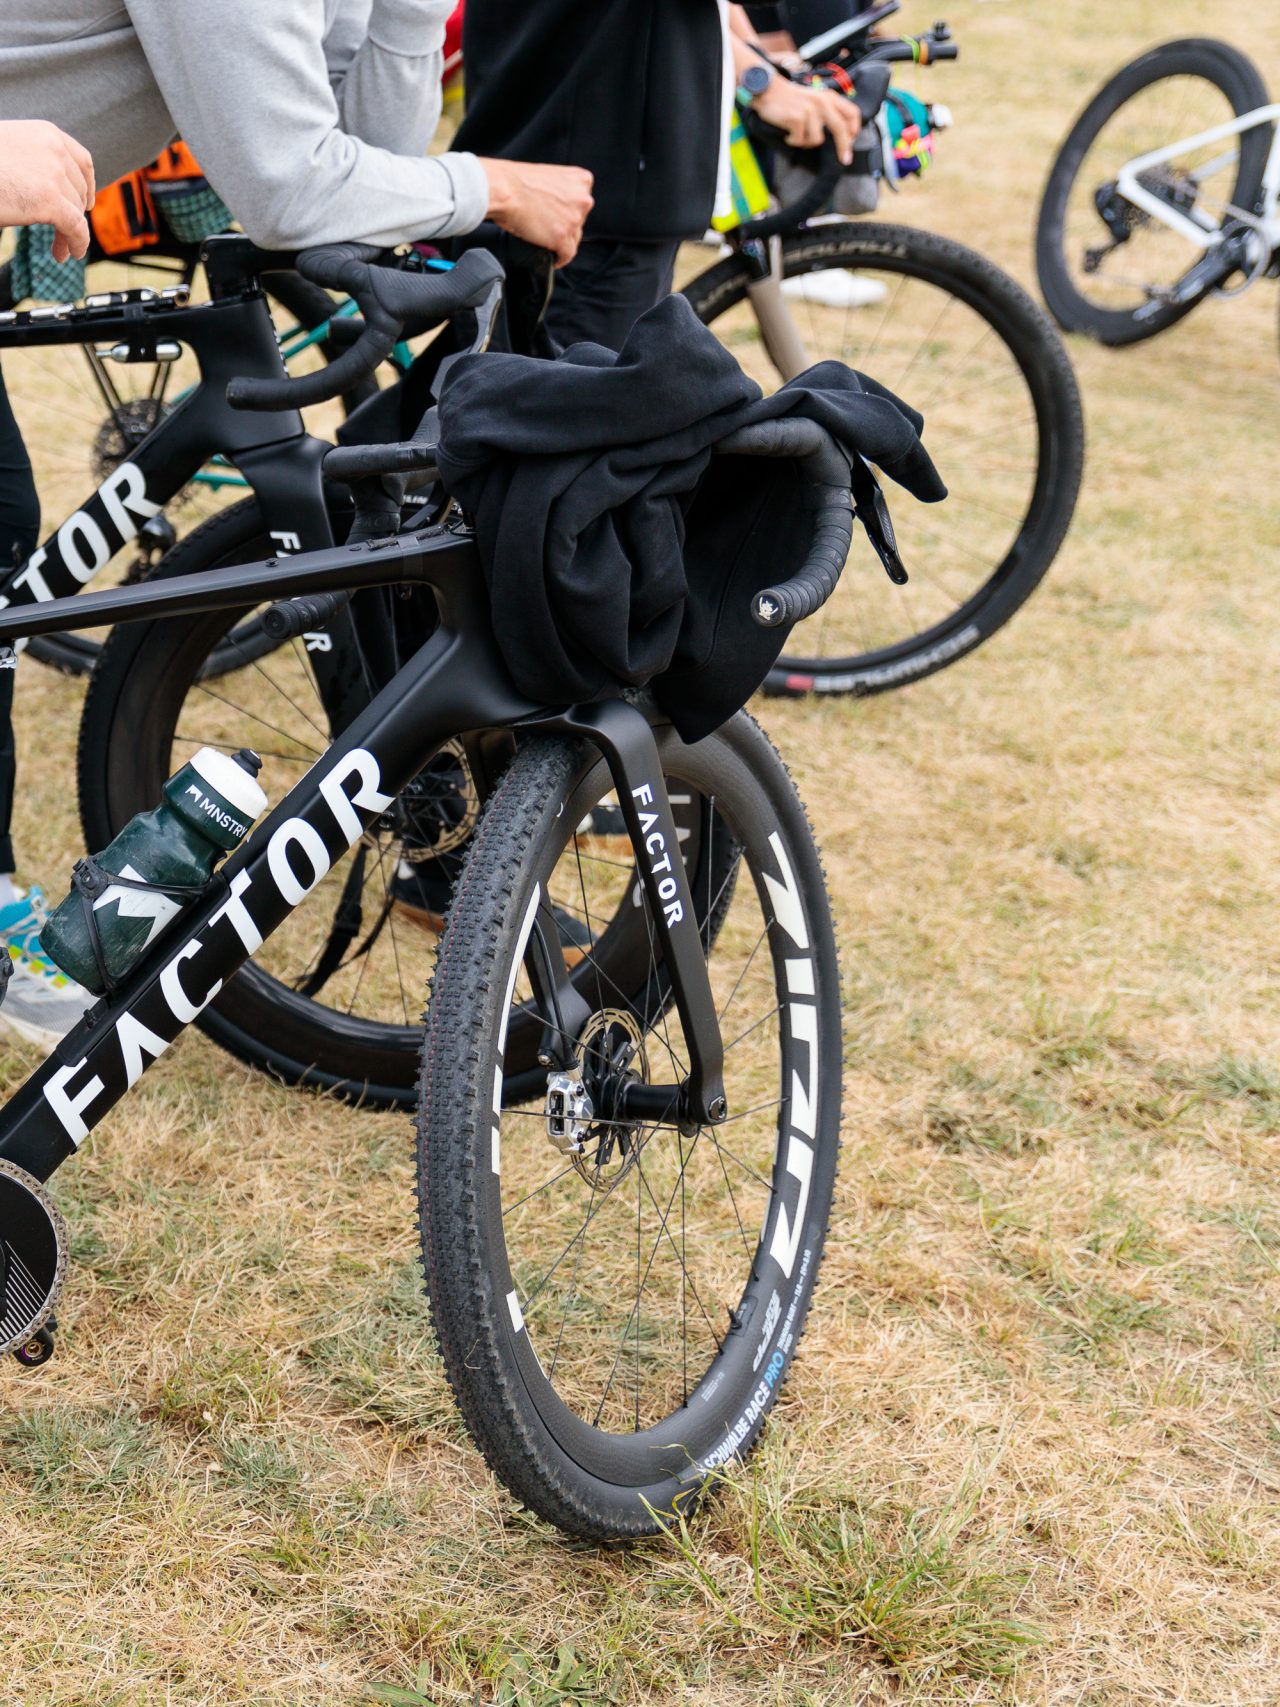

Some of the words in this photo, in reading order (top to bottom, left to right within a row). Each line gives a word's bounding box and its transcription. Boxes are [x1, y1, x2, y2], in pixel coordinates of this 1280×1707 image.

[199, 797, 248, 838] MNSTRY
[632, 783, 683, 929] FACTOR
[43, 748, 396, 1147] FACTOR
[704, 1417, 750, 1469] SCHWALBE
[745, 1381, 770, 1425] RACE
[764, 1351, 785, 1389] PRO
